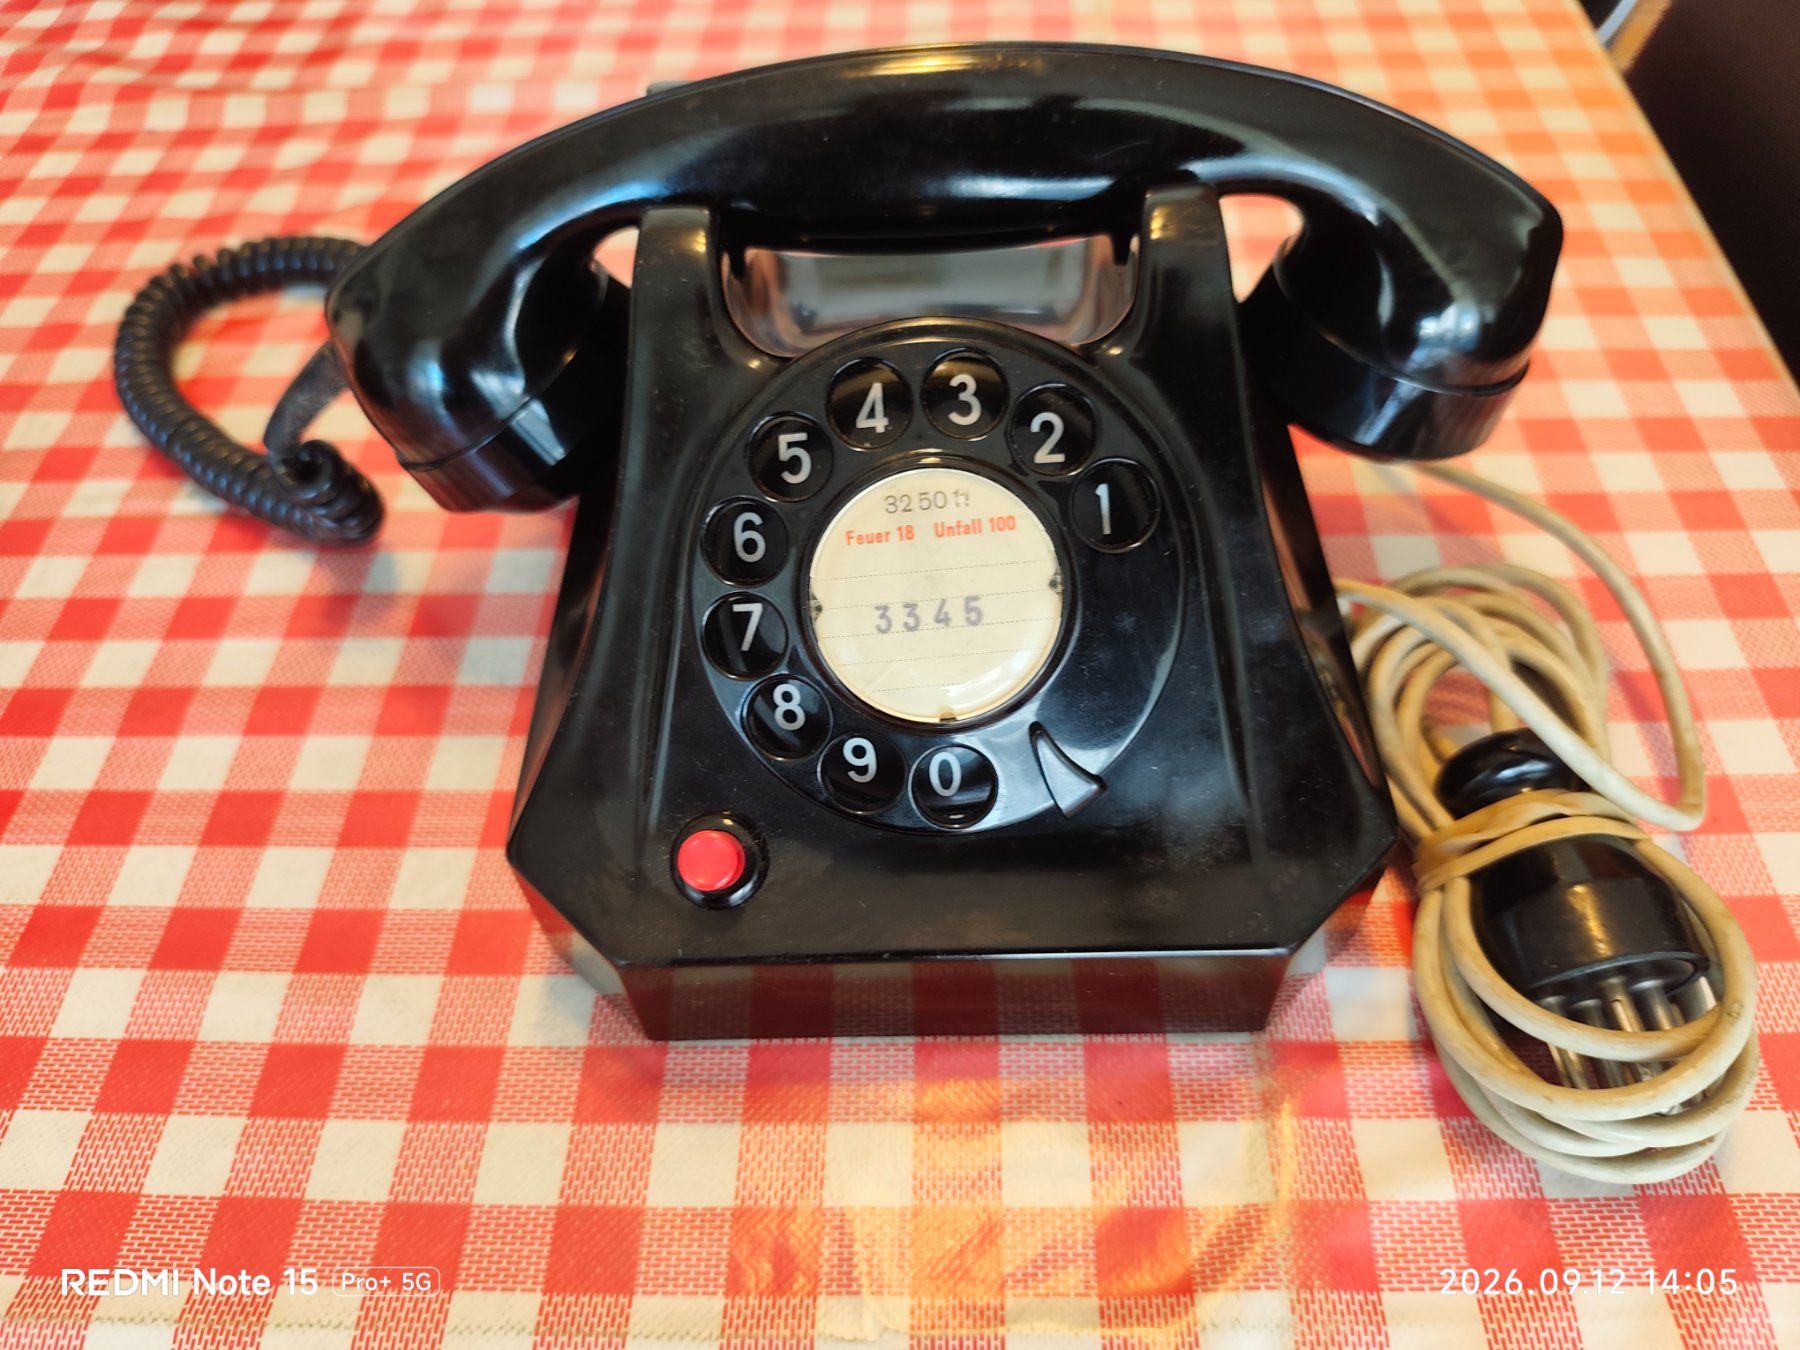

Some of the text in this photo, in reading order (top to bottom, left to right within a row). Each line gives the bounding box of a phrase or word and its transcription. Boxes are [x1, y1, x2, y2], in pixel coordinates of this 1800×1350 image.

[856, 382, 890, 434] 4
[948, 374, 983, 426] 3
[777, 432, 812, 484] 5
[1030, 412, 1067, 464] 2
[845, 515, 1017, 546] Feuer 18 Unfall 100
[1095, 483, 1112, 535] 1
[733, 512, 767, 563] 6
[732, 603, 763, 652] 7
[772, 684, 806, 731] 8
[842, 737, 878, 783] 9
[928, 752, 962, 797] 0
